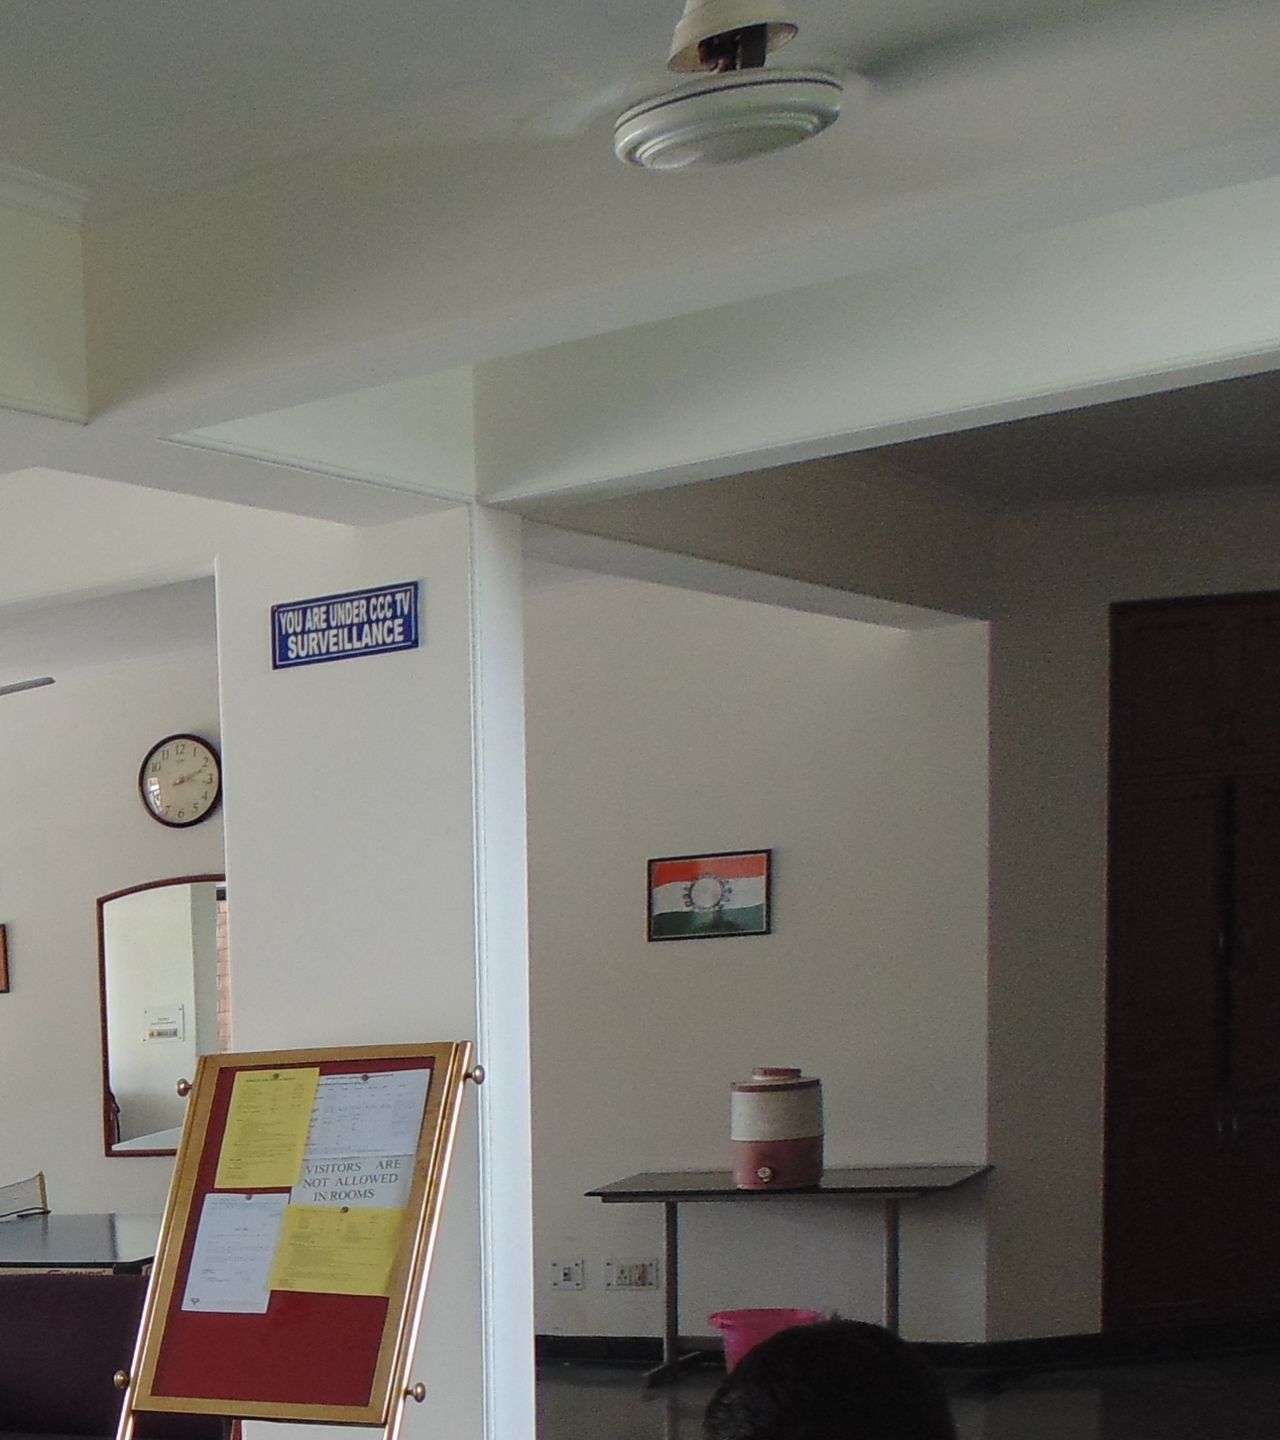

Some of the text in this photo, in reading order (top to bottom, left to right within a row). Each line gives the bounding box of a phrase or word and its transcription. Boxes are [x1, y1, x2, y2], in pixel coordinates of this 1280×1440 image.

[279, 592, 411, 634] YOU ARE UNDER CCC TV
[288, 619, 404, 658] SURVEILLANCE
[176, 744, 185, 755] 12
[306, 1160, 400, 1174] VISITORS ARE
[303, 1173, 398, 1188] NOT ALLOWED
[313, 1189, 375, 1202] IN ROOMS
